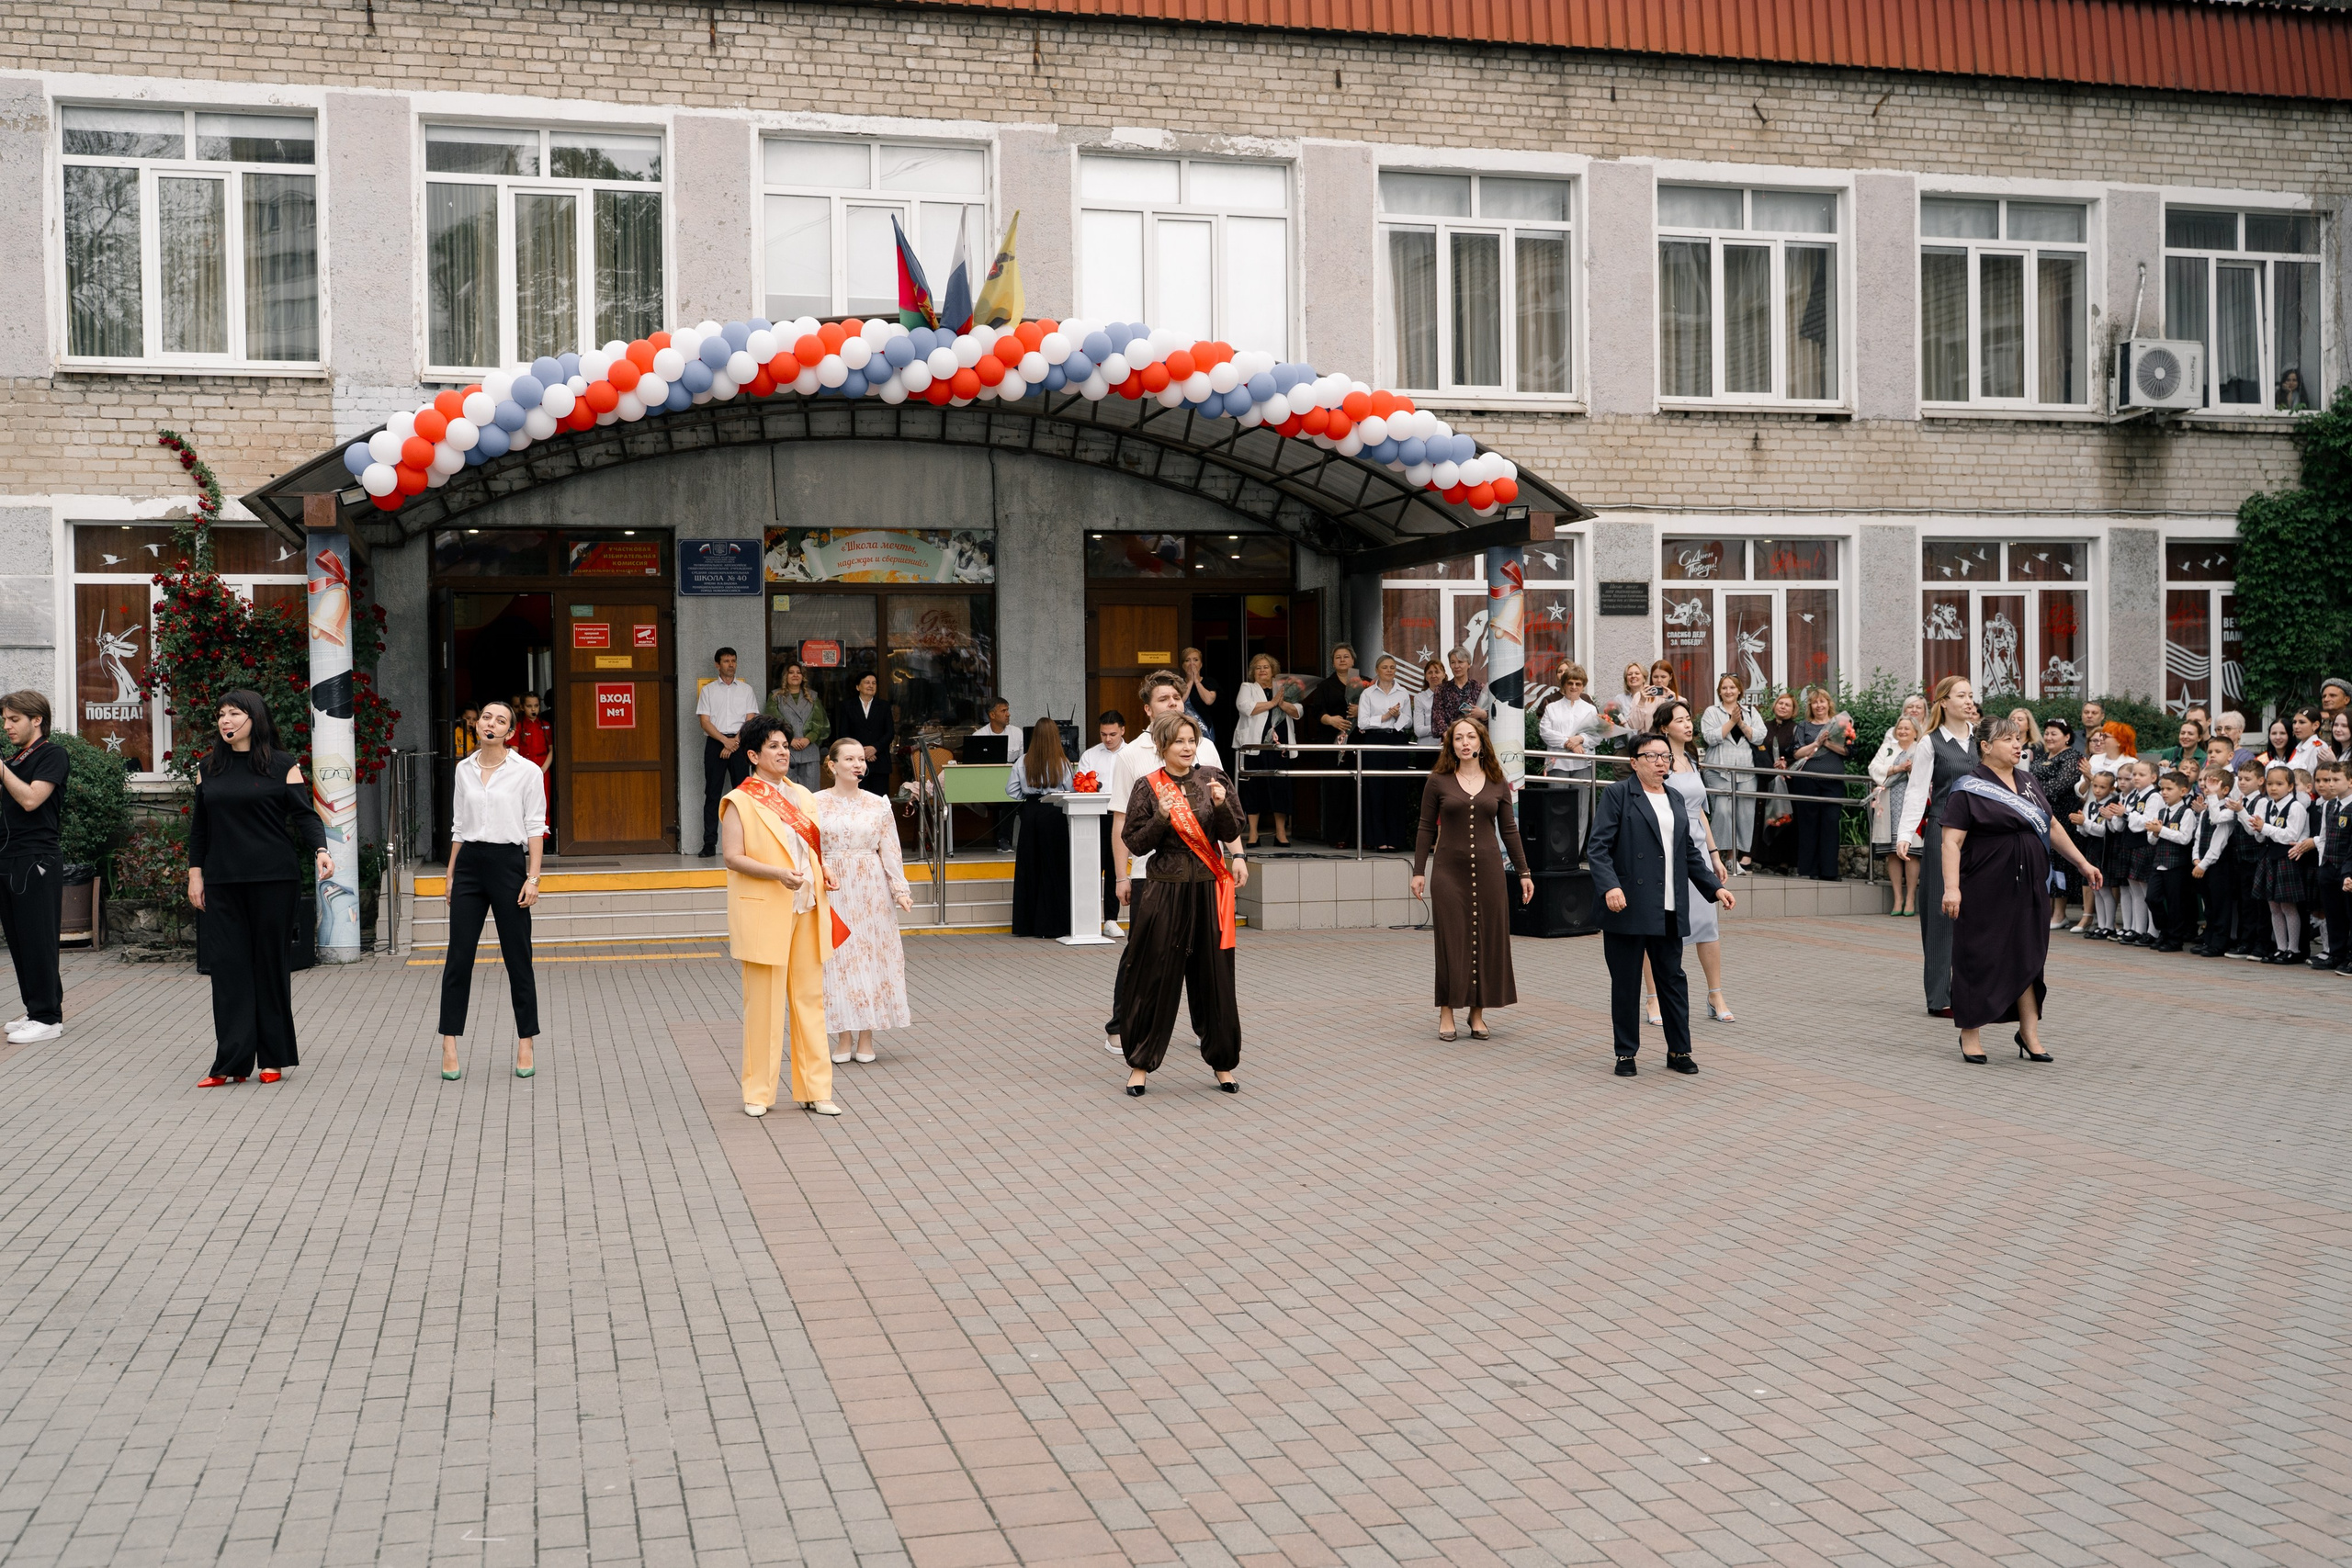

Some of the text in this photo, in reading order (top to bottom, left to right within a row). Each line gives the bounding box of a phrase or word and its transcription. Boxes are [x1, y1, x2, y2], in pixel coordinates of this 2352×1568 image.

[841, 540, 917, 555] «Школа мечты,
[837, 556, 874, 568] надежды
[882, 555, 929, 568] свершений!»
[1692, 631, 1706, 639] ДЕДУ
[1670, 638, 1703, 647] ЗА ПОБЕДУ!
[599, 694, 632, 705] ВХОД
[85, 706, 143, 722] ПОБЕДА!
[606, 708, 625, 717] №1
